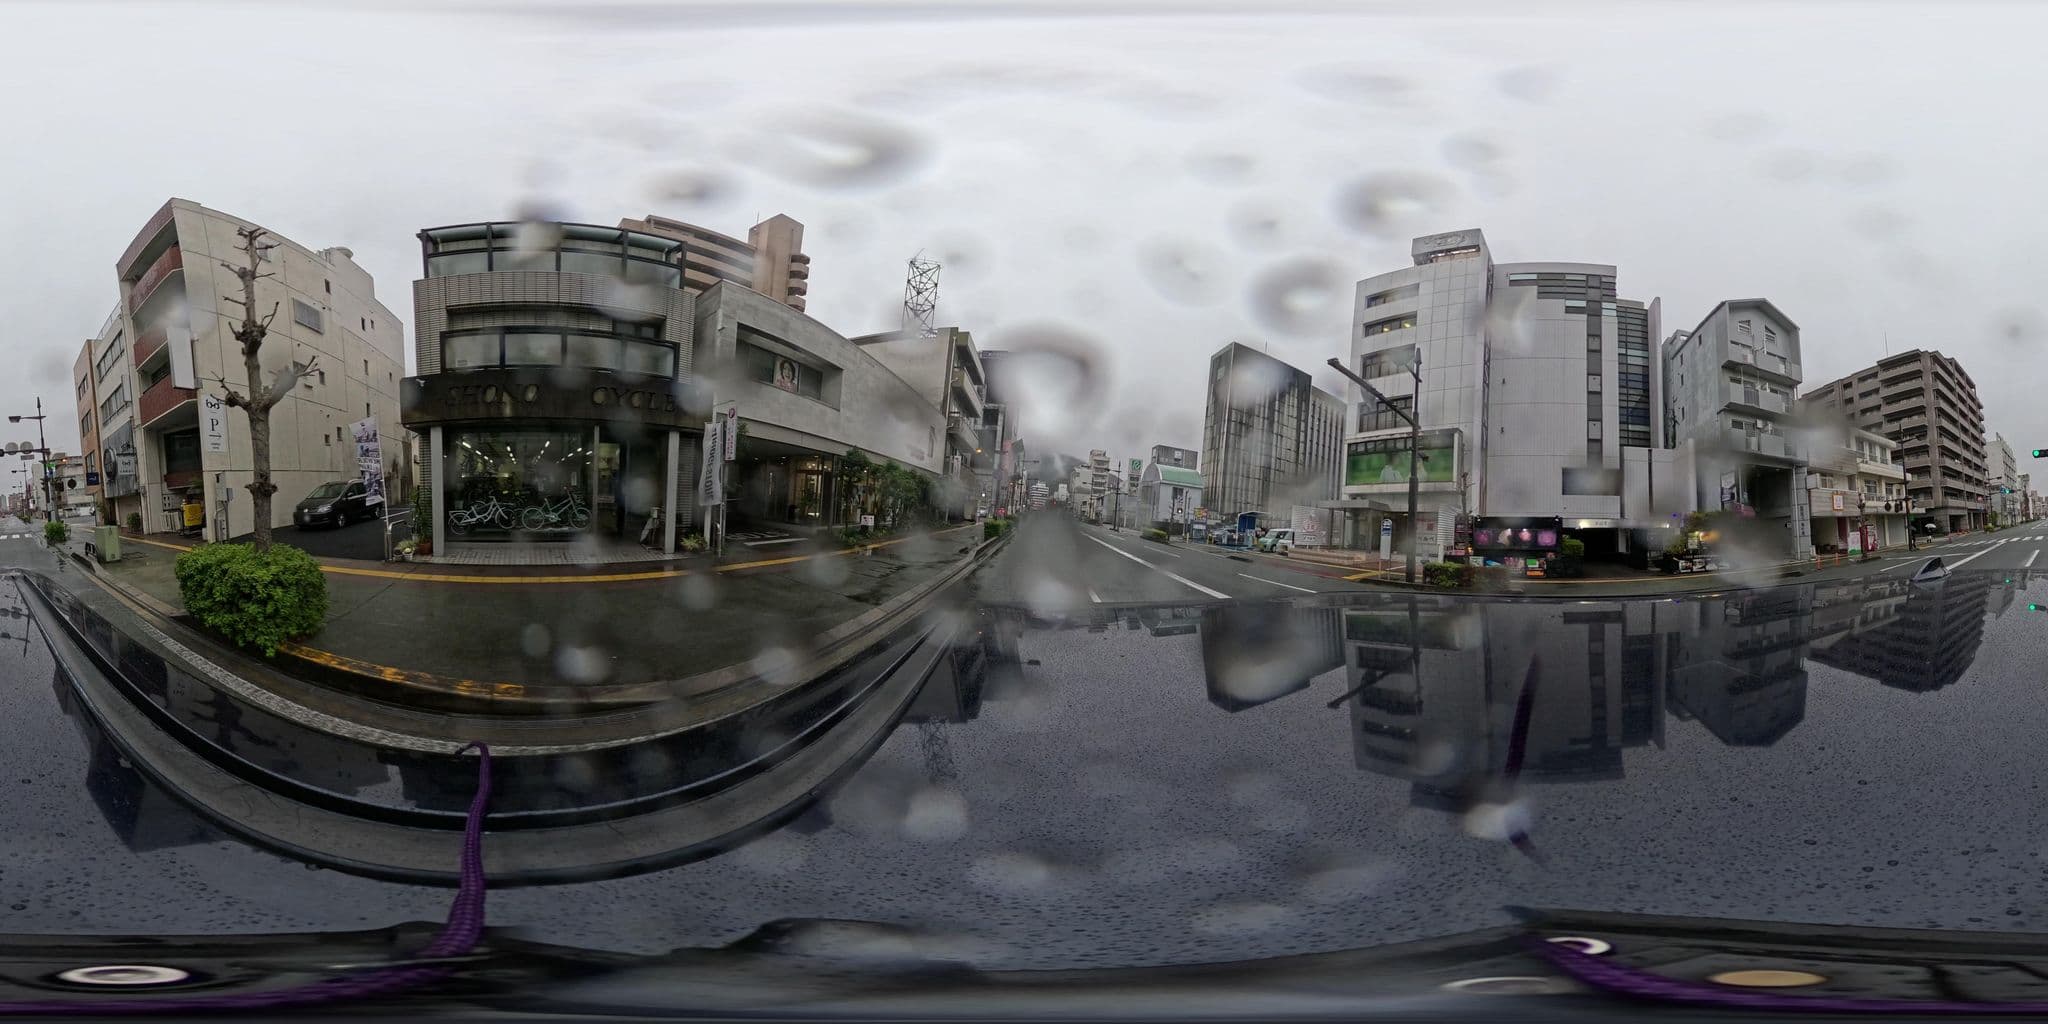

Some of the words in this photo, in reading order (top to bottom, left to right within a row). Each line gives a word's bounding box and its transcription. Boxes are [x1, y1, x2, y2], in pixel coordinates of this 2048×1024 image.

[447, 384, 539, 406] SHONO
[592, 385, 678, 412] CYCLE
[210, 418, 219, 432] P
